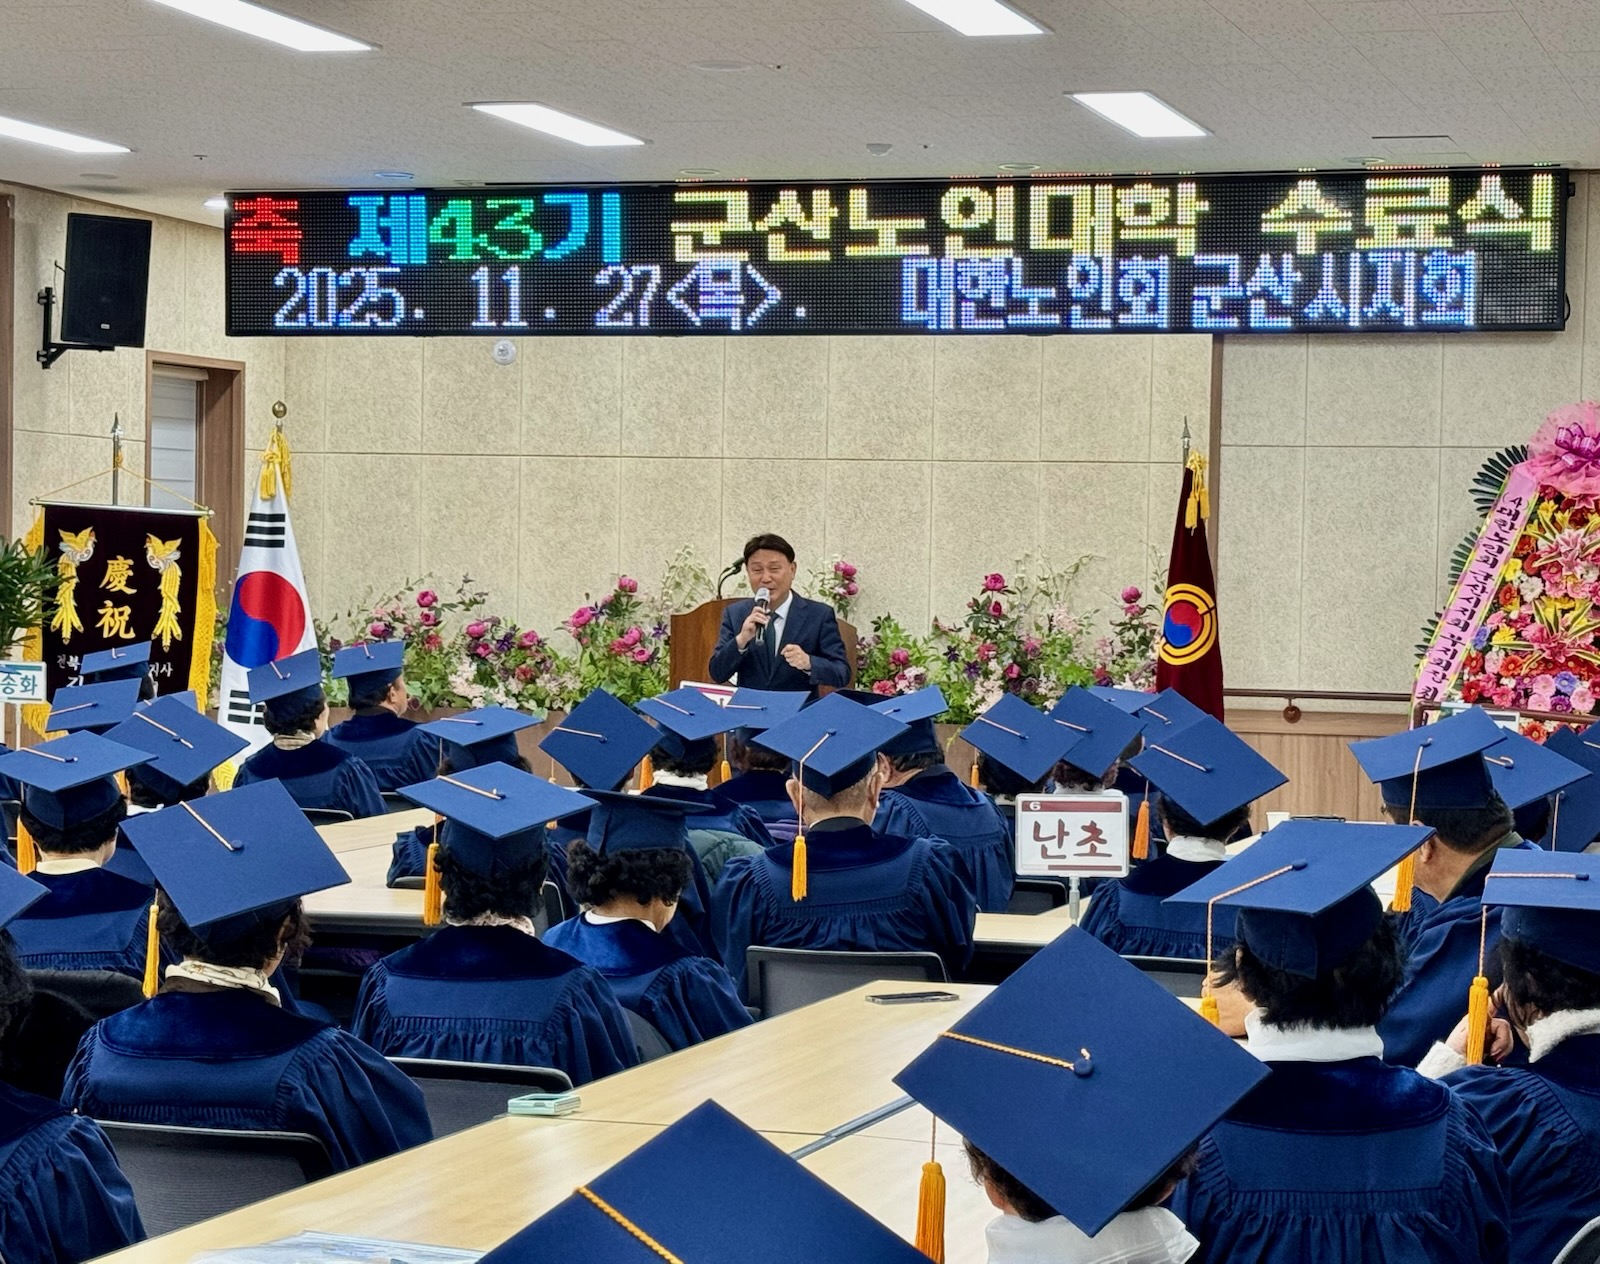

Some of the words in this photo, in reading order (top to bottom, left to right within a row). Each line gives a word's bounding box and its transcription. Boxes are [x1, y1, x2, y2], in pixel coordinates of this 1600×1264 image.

[231, 197, 303, 264] 축
[348, 193, 621, 264] 제43기
[670, 182, 1210, 263] 군산노인대학
[1260, 173, 1553, 255] 수료식
[274, 266, 425, 328] 2025.
[471, 265, 556, 328] 11.
[902, 255, 1170, 330] 대한노인회
[1192, 249, 1477, 328] 군산시지회
[95, 555, 138, 639] 慶祝
[1029, 801, 1041, 811] 6
[1033, 818, 1113, 860] 난초
